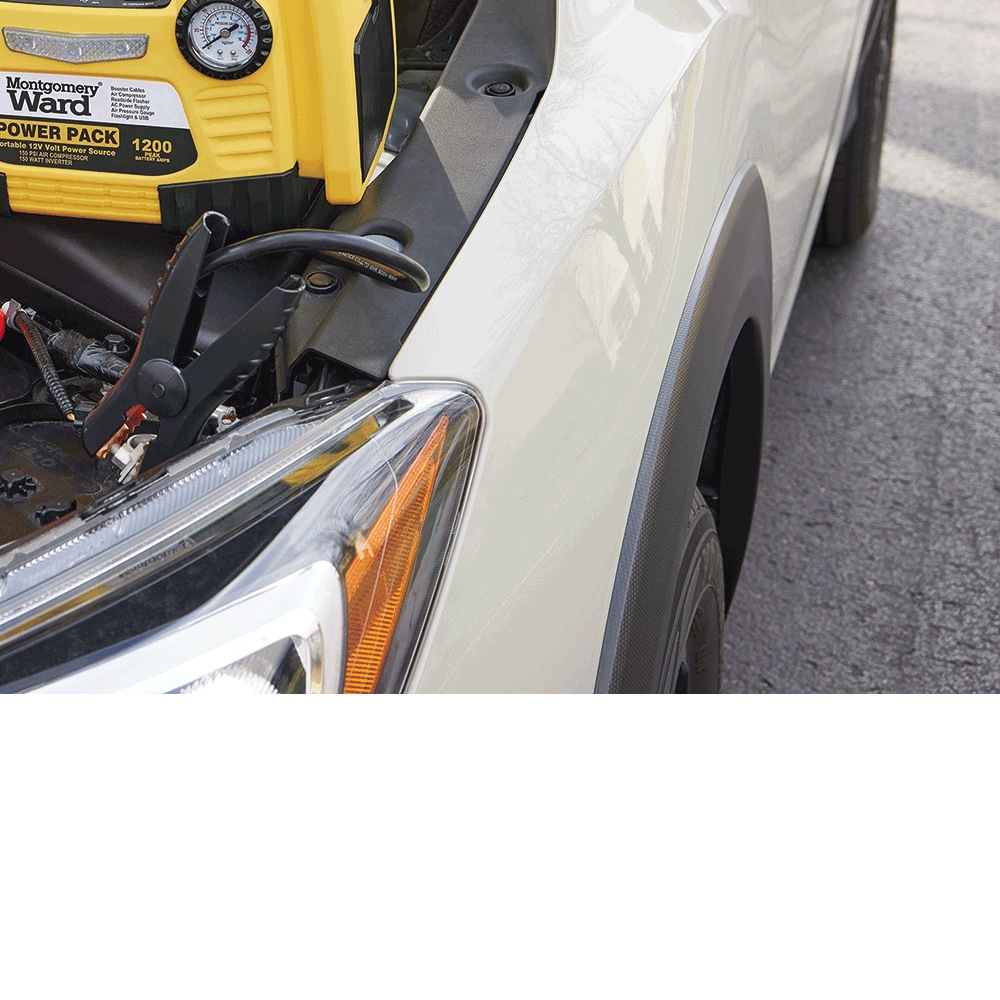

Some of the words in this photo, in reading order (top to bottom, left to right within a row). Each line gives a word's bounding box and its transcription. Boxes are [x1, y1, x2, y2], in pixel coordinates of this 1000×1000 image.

[6, 76, 99, 98] Montgomery
[6, 89, 92, 116] Ward
[67, 126, 118, 145] PACK
[29, 142, 43, 150] 12V
[62, 145, 87, 154] Power
[88, 147, 116, 156] Source
[132, 138, 172, 154] 1200
[45, 158, 73, 166] INVERTER
[49, 152, 89, 162] COMPRESSOR
